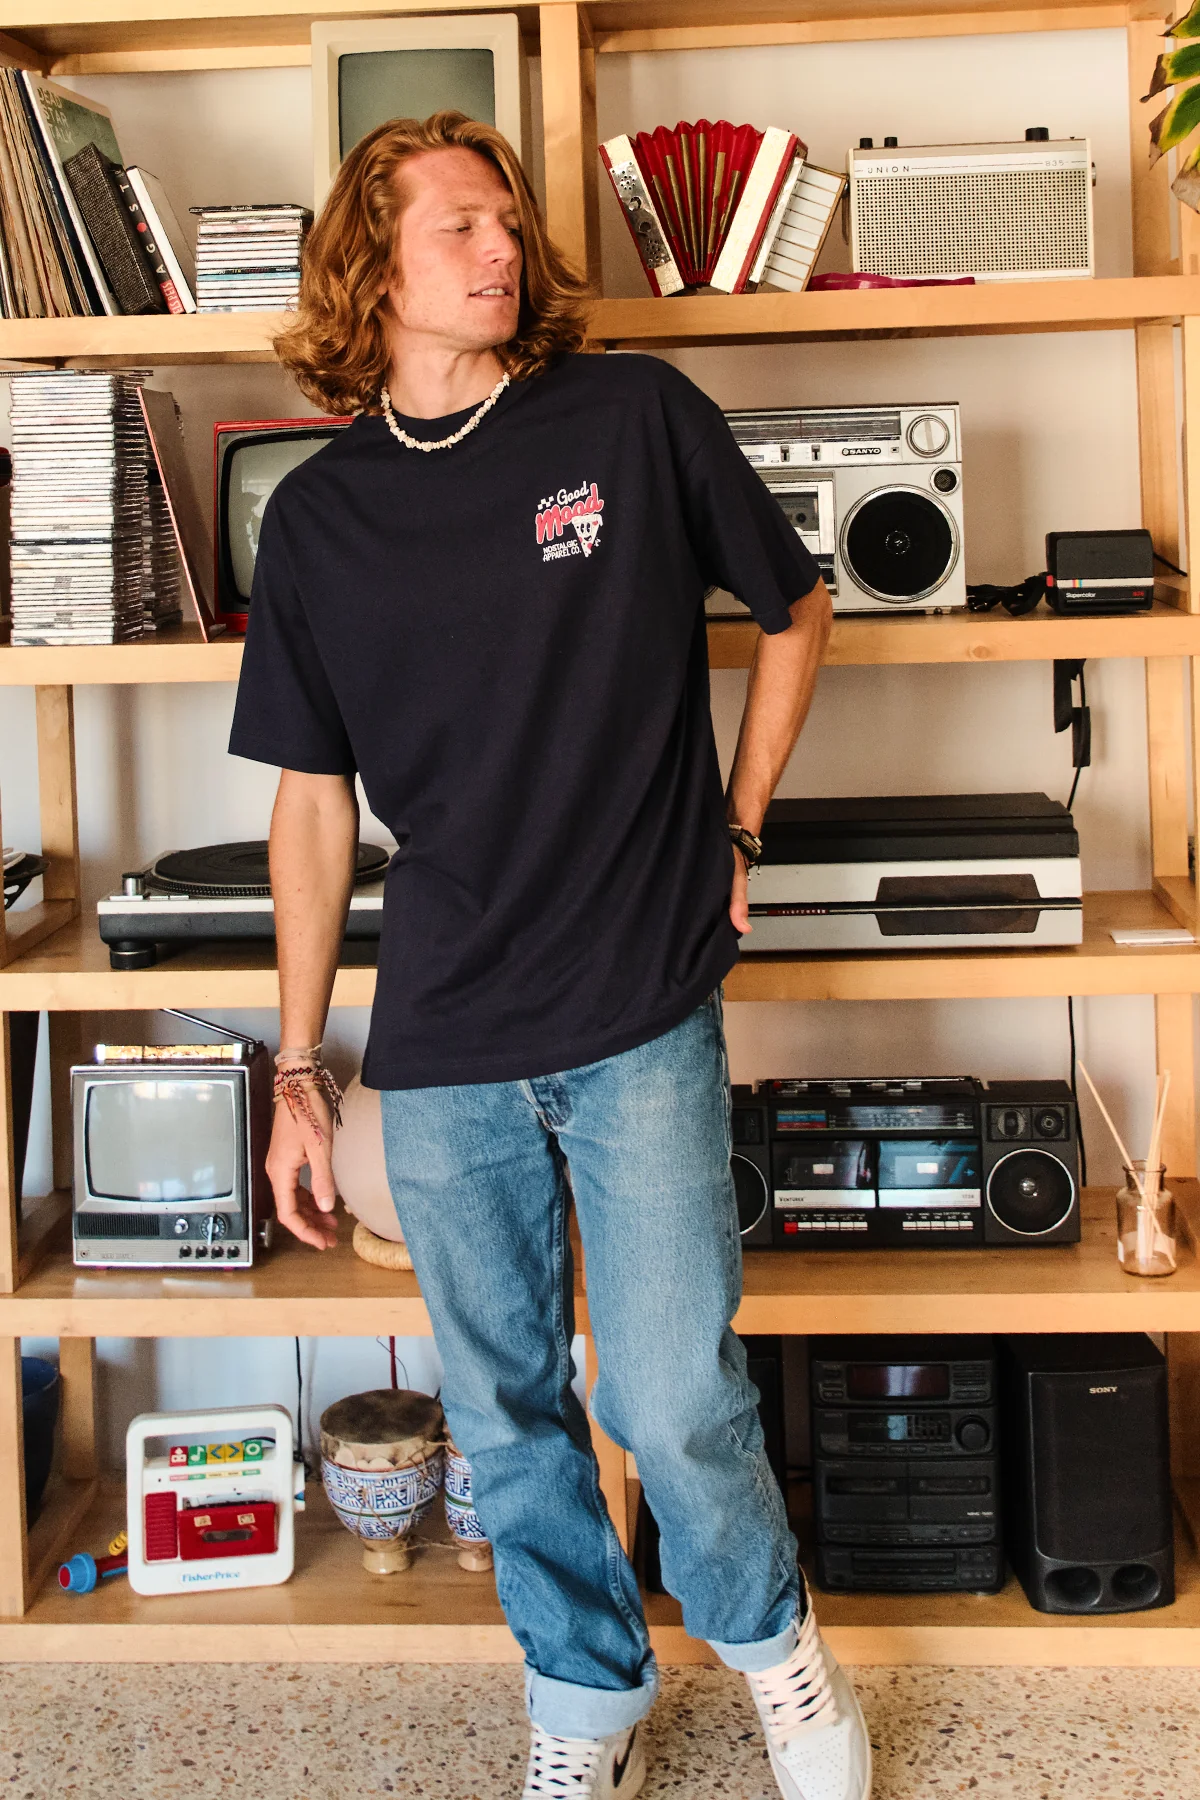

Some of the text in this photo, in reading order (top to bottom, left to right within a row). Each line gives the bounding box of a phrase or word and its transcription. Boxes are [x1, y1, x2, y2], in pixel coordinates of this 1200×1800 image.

[867, 165, 910, 174] UNION
[162, 282, 176, 300] PETS
[556, 480, 590, 505] Good
[535, 482, 605, 545] Mood
[543, 540, 578, 554] NOSTALGIC
[543, 549, 571, 562] APPAREL
[1089, 1386, 1118, 1394] SONY
